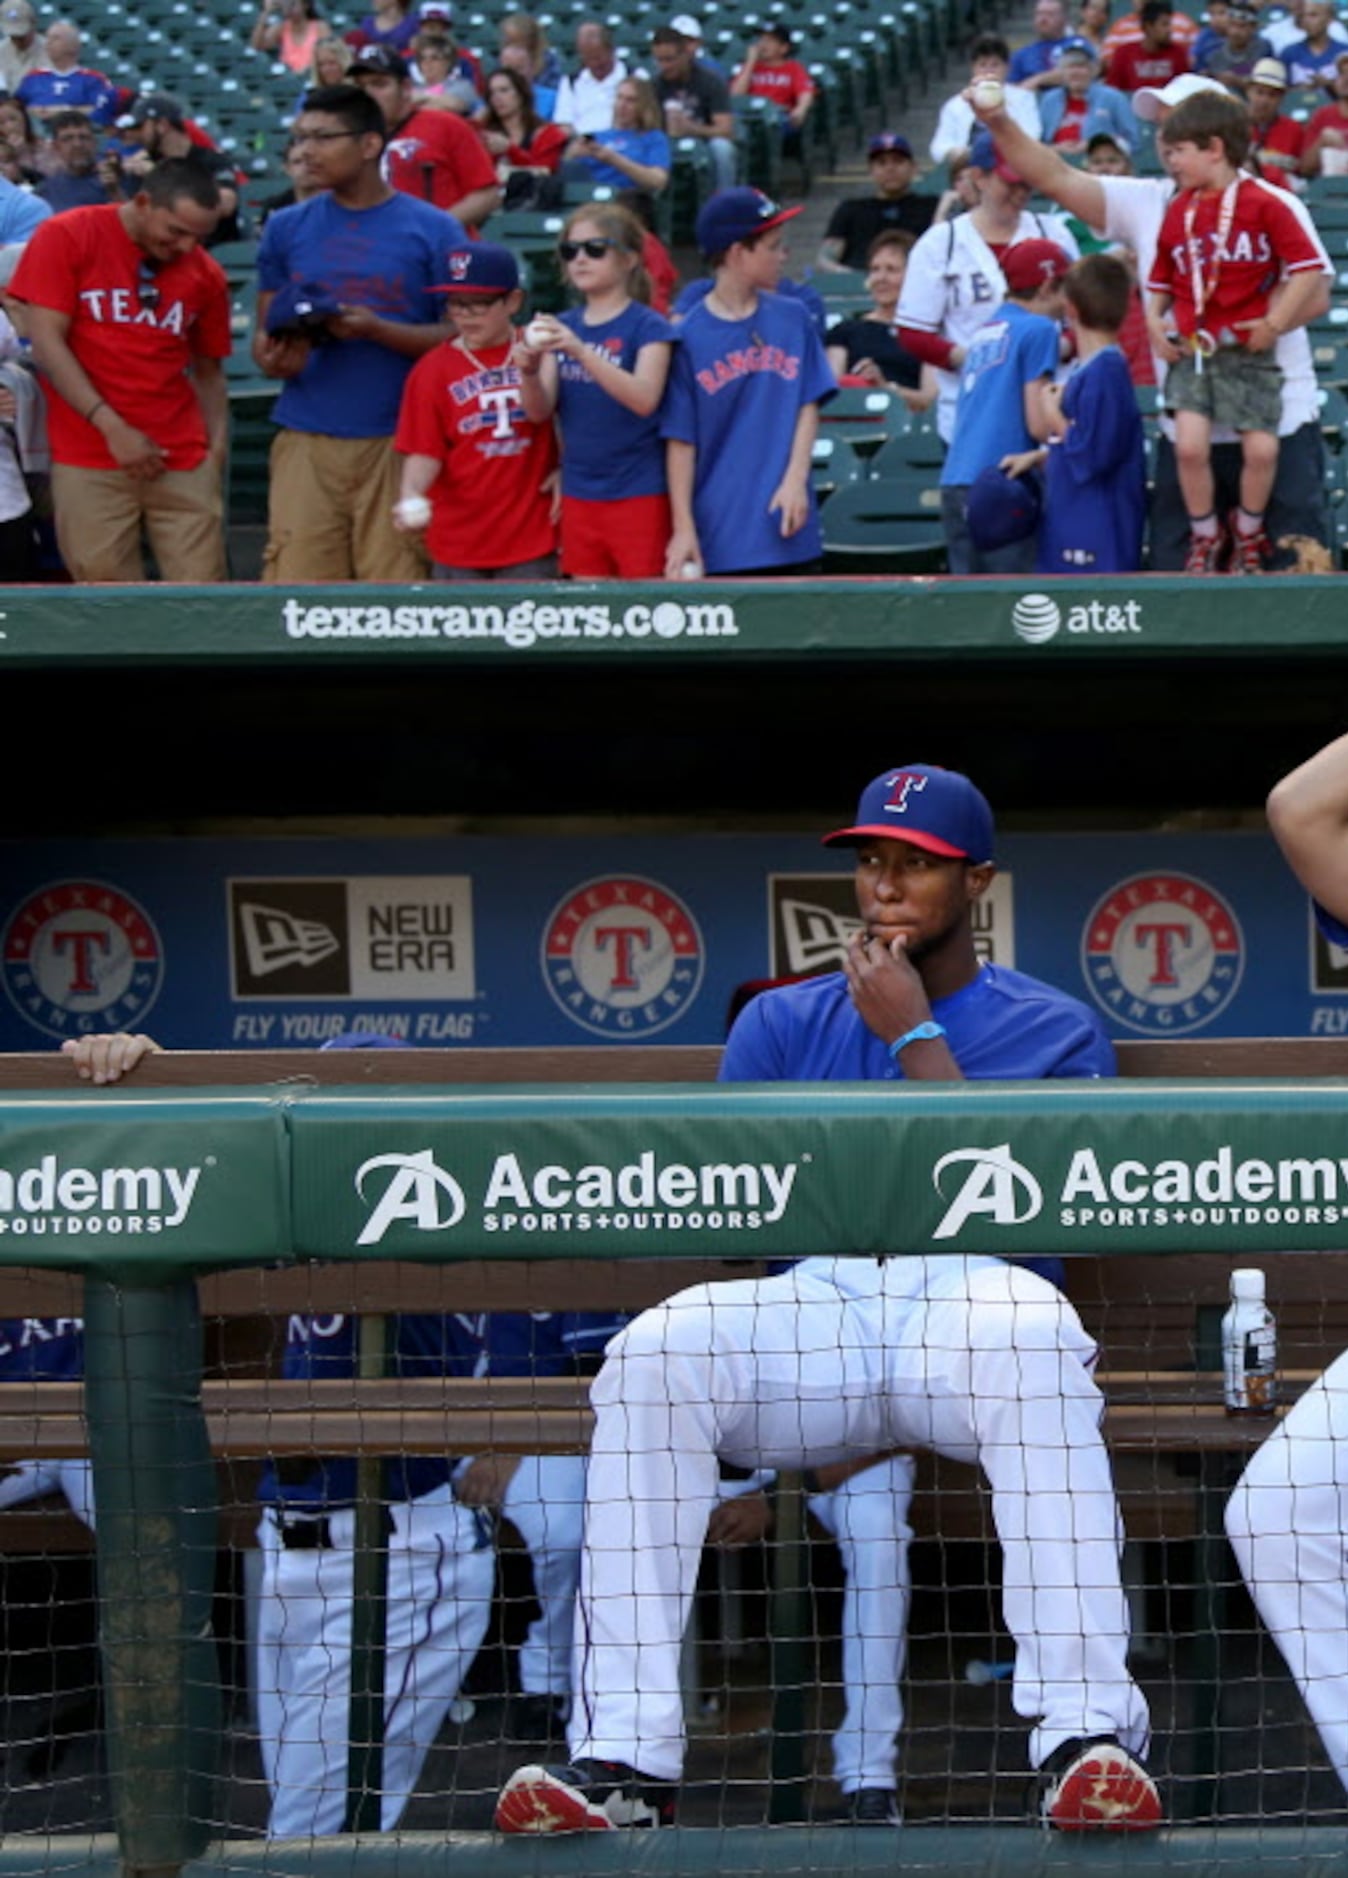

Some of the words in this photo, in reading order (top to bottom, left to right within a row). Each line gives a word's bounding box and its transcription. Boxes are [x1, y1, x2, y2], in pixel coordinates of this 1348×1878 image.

[282, 599, 739, 649] texasrangers.com
[1067, 600, 1142, 633] at&t
[883, 772, 928, 813] T
[368, 903, 455, 937] NEW
[52, 930, 112, 996] T
[369, 939, 455, 973] ERA
[593, 926, 653, 991] T
[1133, 923, 1193, 989] T
[232, 1014, 275, 1041] FLY
[415, 1012, 476, 1039] FLAG
[483, 1151, 797, 1222] Academy
[483, 1211, 762, 1231] SPORTS+OUTDOORS
[1060, 1206, 1339, 1226] SPORTS+OUTDOORS
